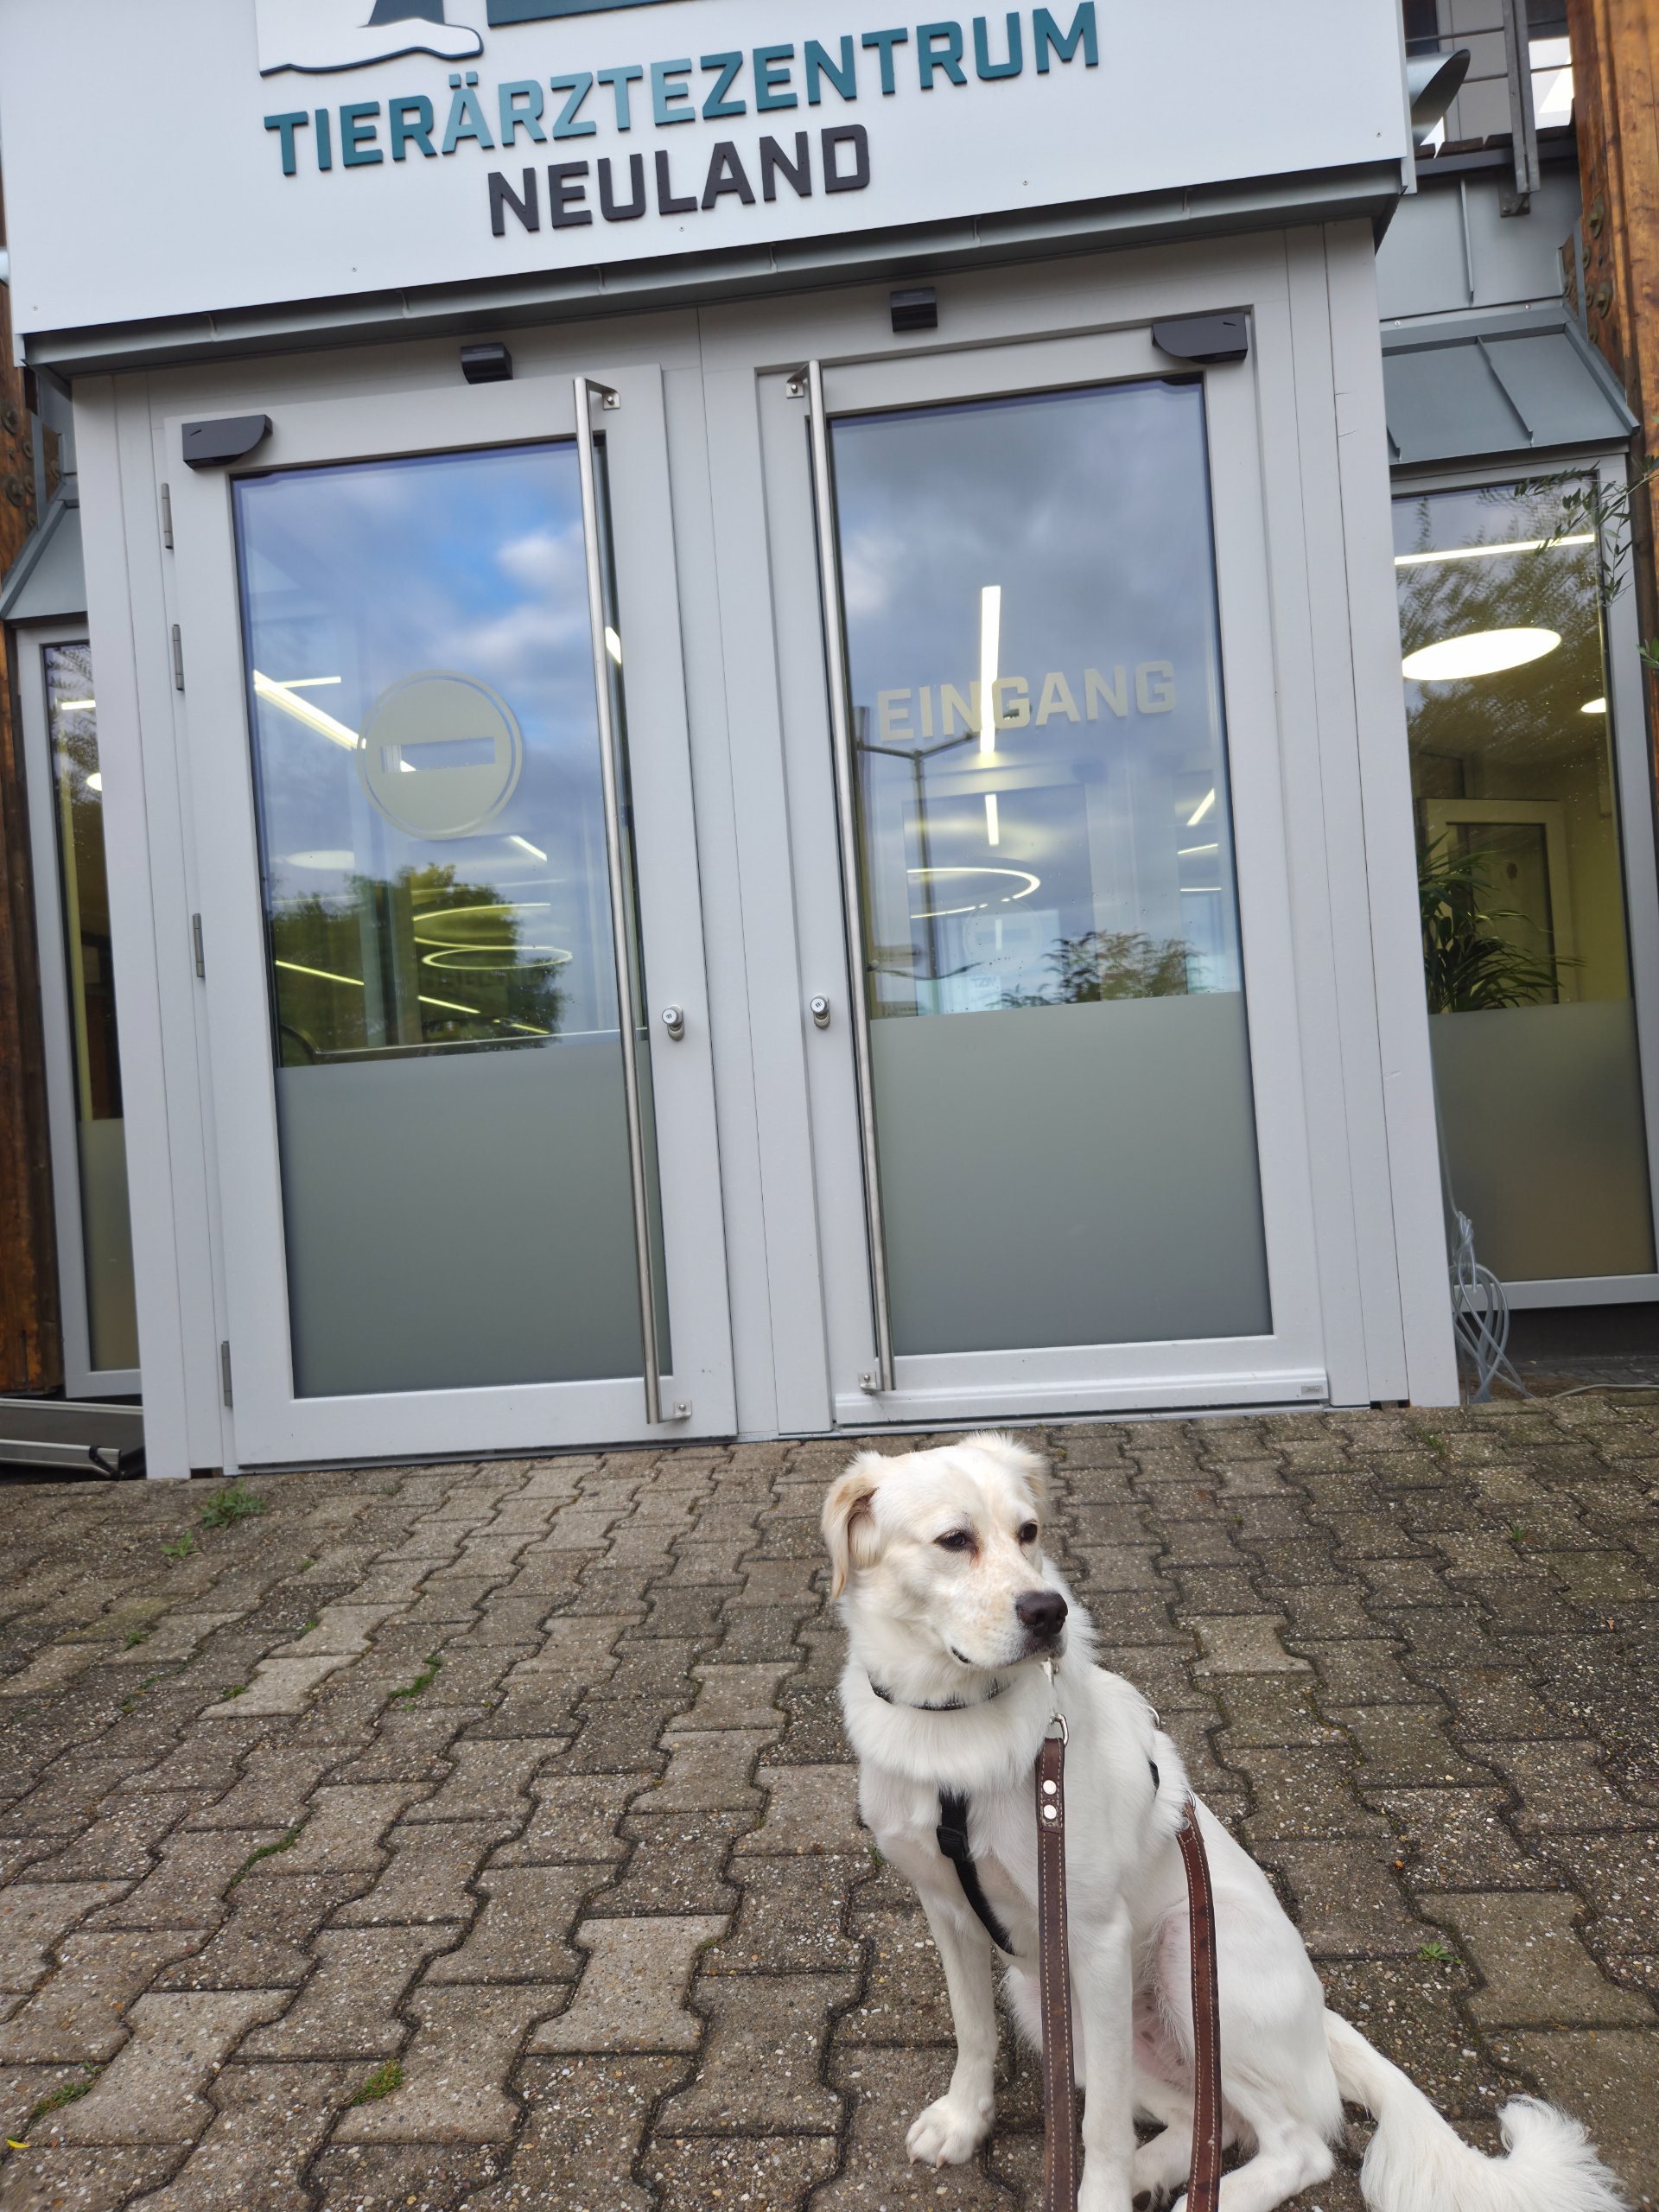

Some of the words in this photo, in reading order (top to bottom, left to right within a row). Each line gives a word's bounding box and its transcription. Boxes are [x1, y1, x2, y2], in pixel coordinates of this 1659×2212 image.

[264, 1, 1099, 178] TIERÄRZTEZENTRUM
[488, 124, 870, 238] NEULAND
[876, 659, 1177, 742] EINGANG
